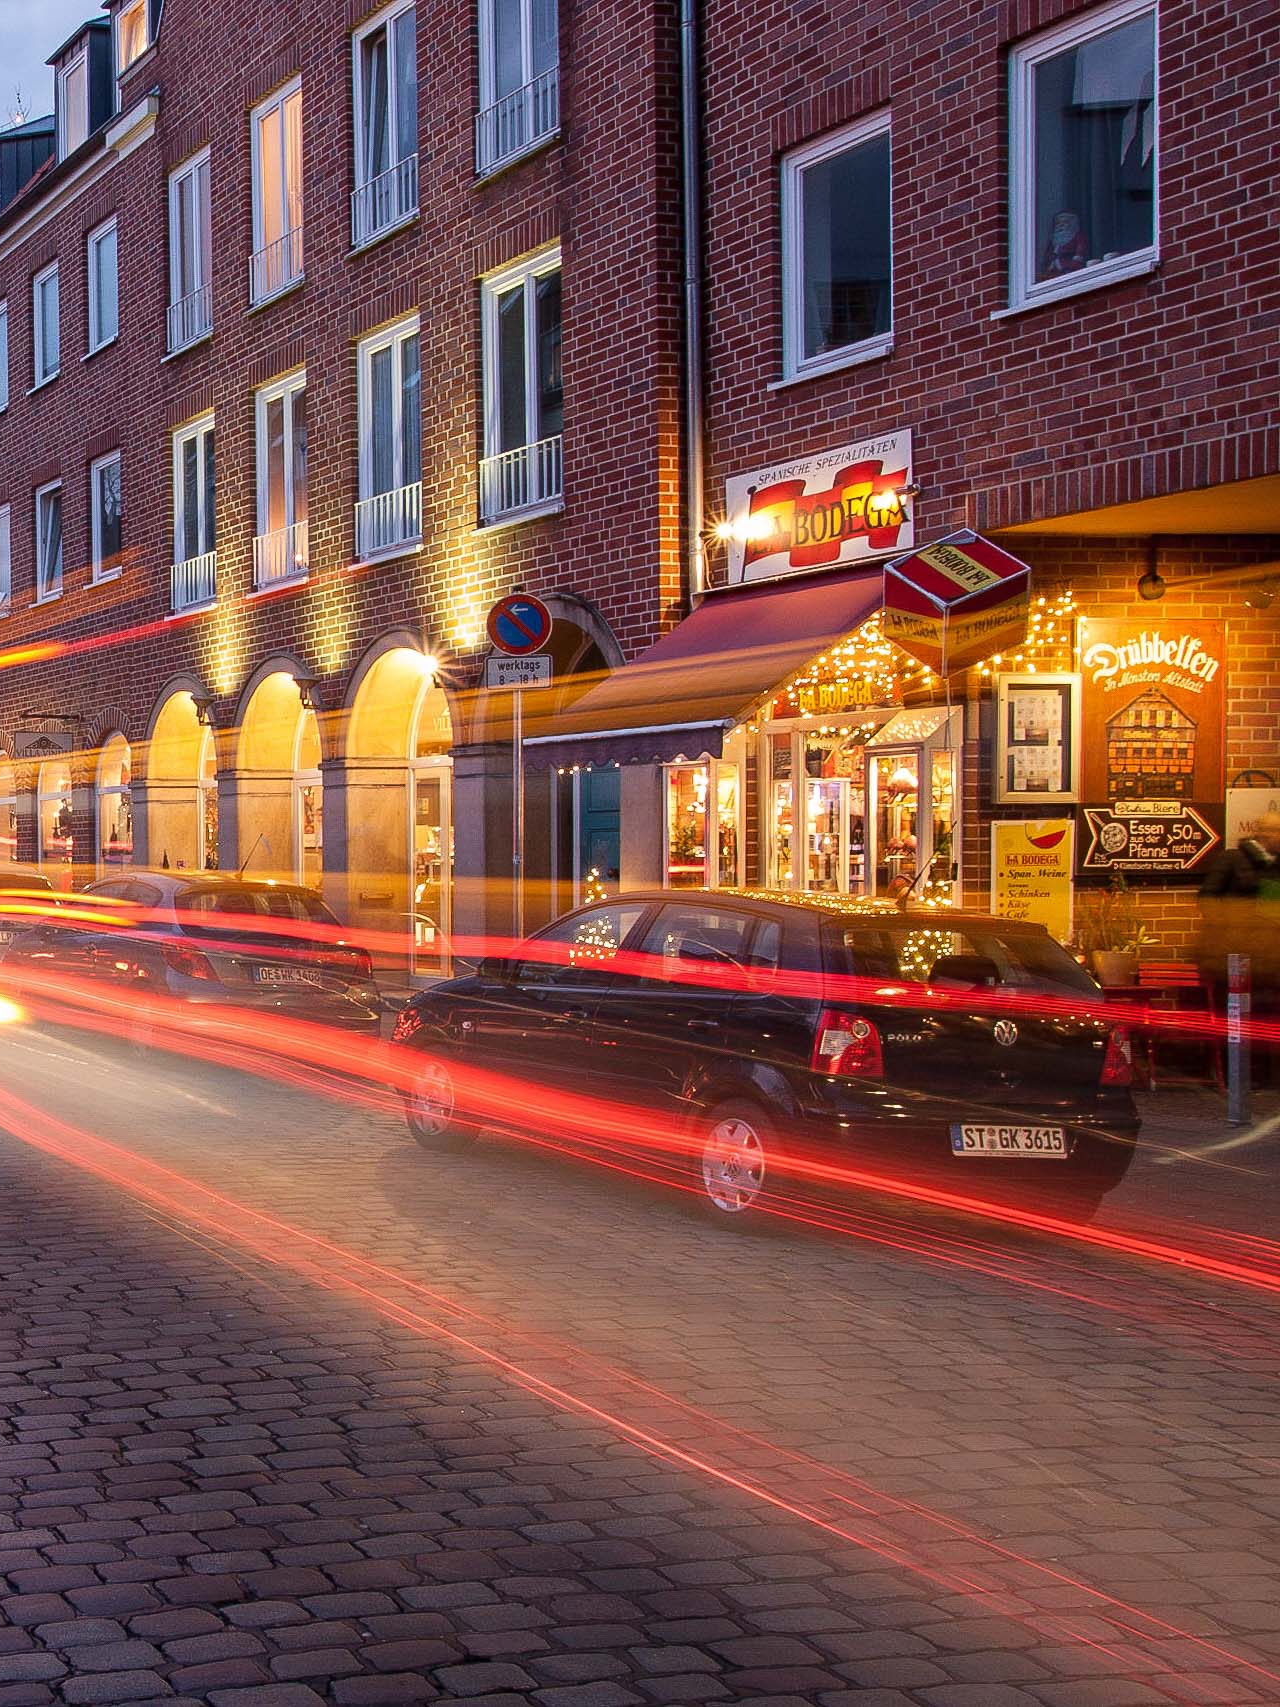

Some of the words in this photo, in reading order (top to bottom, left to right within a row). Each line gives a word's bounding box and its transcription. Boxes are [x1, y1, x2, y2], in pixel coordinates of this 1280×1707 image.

[757, 461, 813, 487] SPANISCHE
[815, 436, 899, 471] SPEZIALITÄTEN
[792, 492, 910, 547] BODEGA
[497, 660, 541, 672] werktags
[499, 675, 505, 686] 8
[519, 674, 529, 684] 18
[1129, 820, 1164, 835] Essen
[1145, 834, 1160, 844] der
[1129, 843, 1168, 858] Pfanne
[1172, 844, 1197, 854] rechts
[1022, 855, 1059, 865] BODEGA
[1007, 869, 1035, 880] Span.
[1039, 869, 1067, 878] Weine
[1007, 889, 1051, 899] Schinken
[964, 1127, 986, 1149] ST
[998, 1128, 1021, 1149] GK
[1022, 1128, 1063, 1150] 3615
